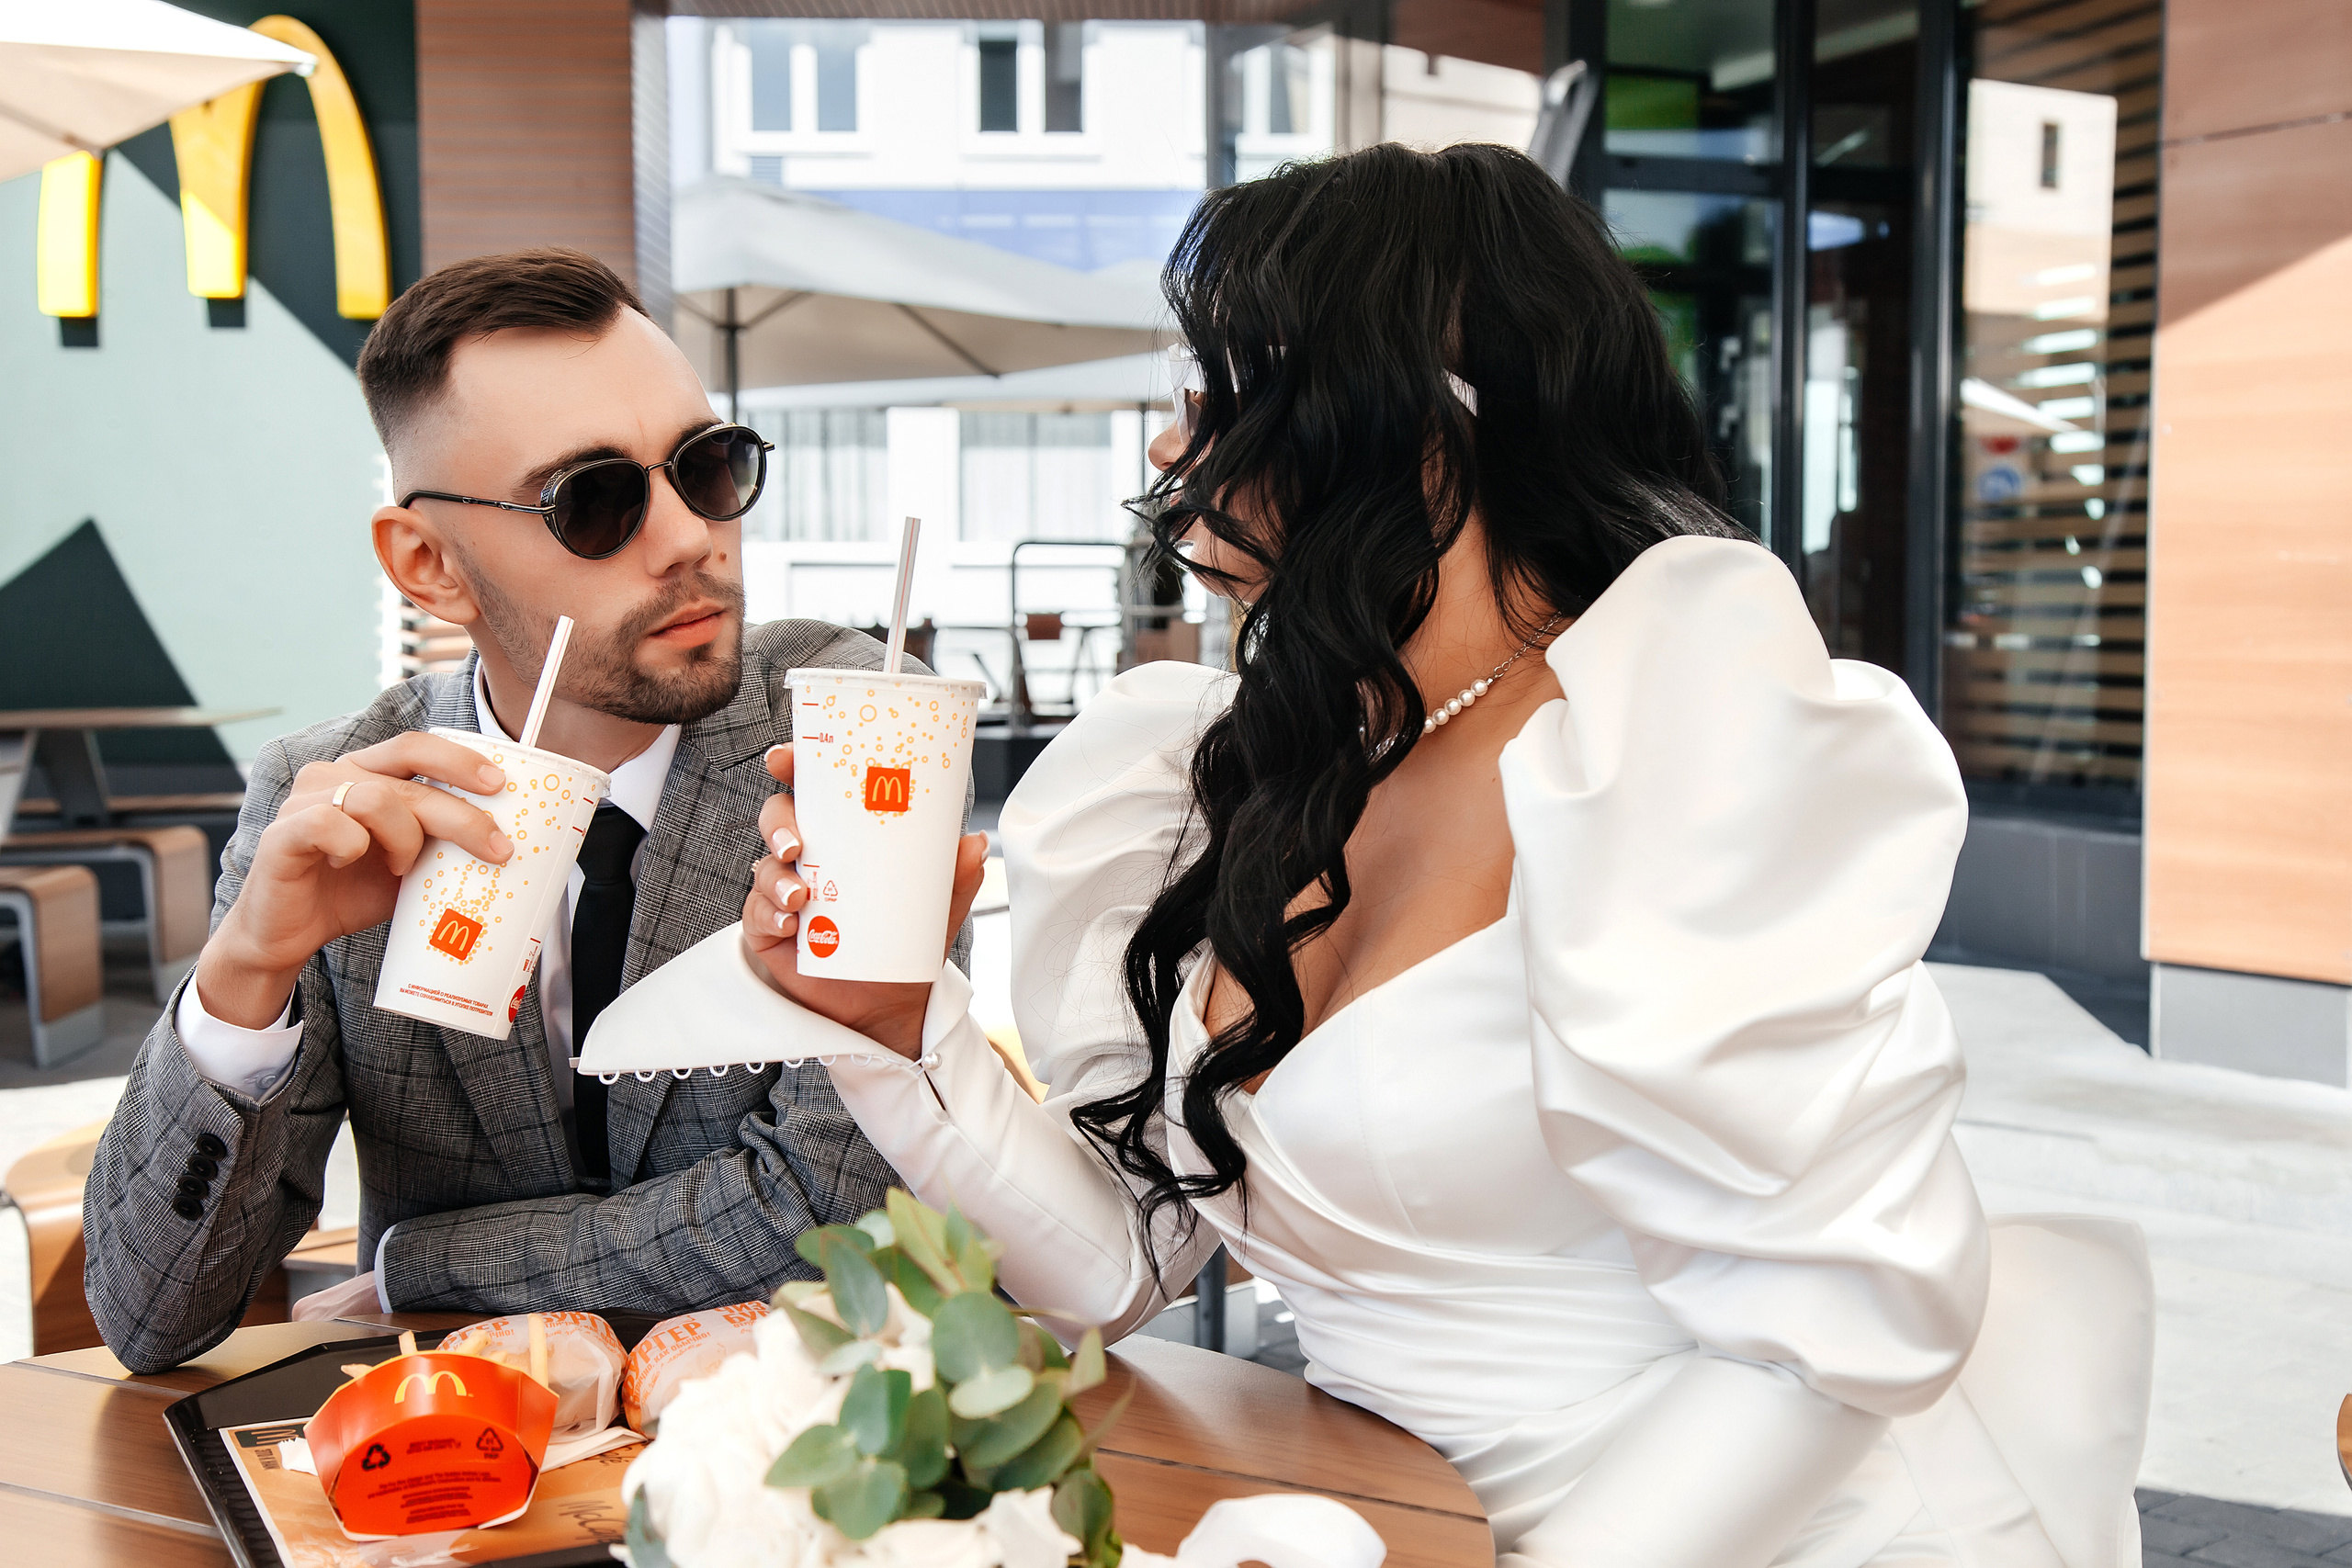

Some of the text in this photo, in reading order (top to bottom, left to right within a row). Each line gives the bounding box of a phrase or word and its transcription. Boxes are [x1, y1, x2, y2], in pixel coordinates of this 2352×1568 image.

[808, 929, 837, 944] Coca-Cola
[653, 1348, 670, 1364] КАК
[671, 1331, 711, 1351] ОБЫЧНО!
